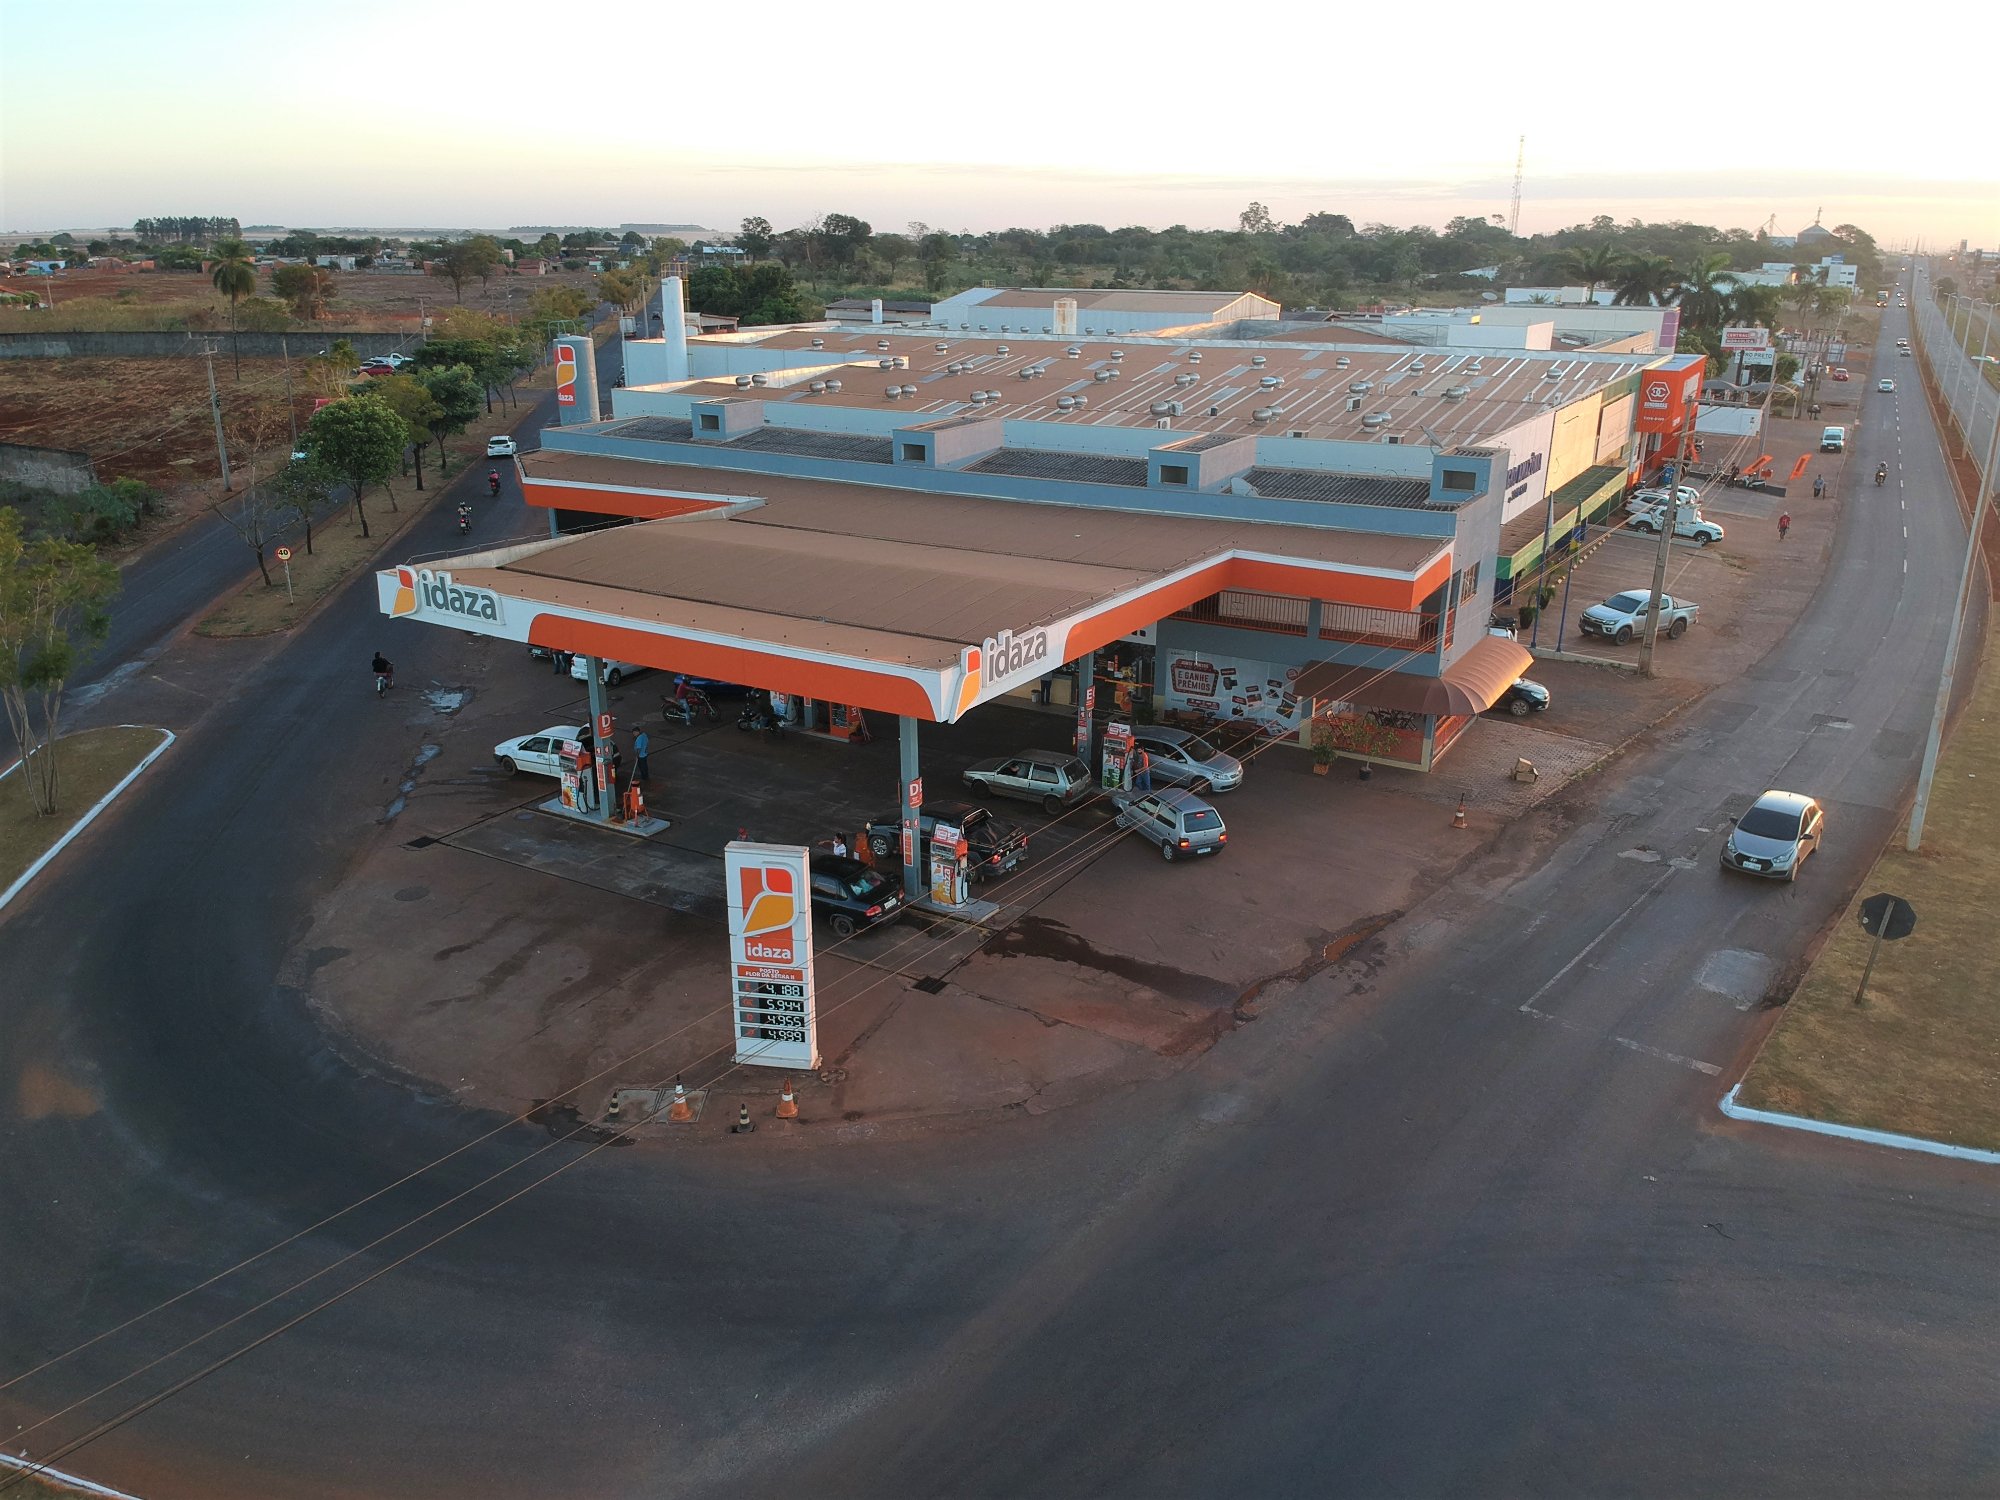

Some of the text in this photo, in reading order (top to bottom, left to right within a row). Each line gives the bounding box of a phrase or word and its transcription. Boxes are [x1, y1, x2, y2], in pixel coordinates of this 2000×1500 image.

[422, 573, 497, 620] idaza
[989, 632, 1046, 682] idaza
[1177, 678, 1210, 691] PRÊMIOS
[1184, 672, 1209, 682] GANHE
[747, 942, 791, 960] idaza
